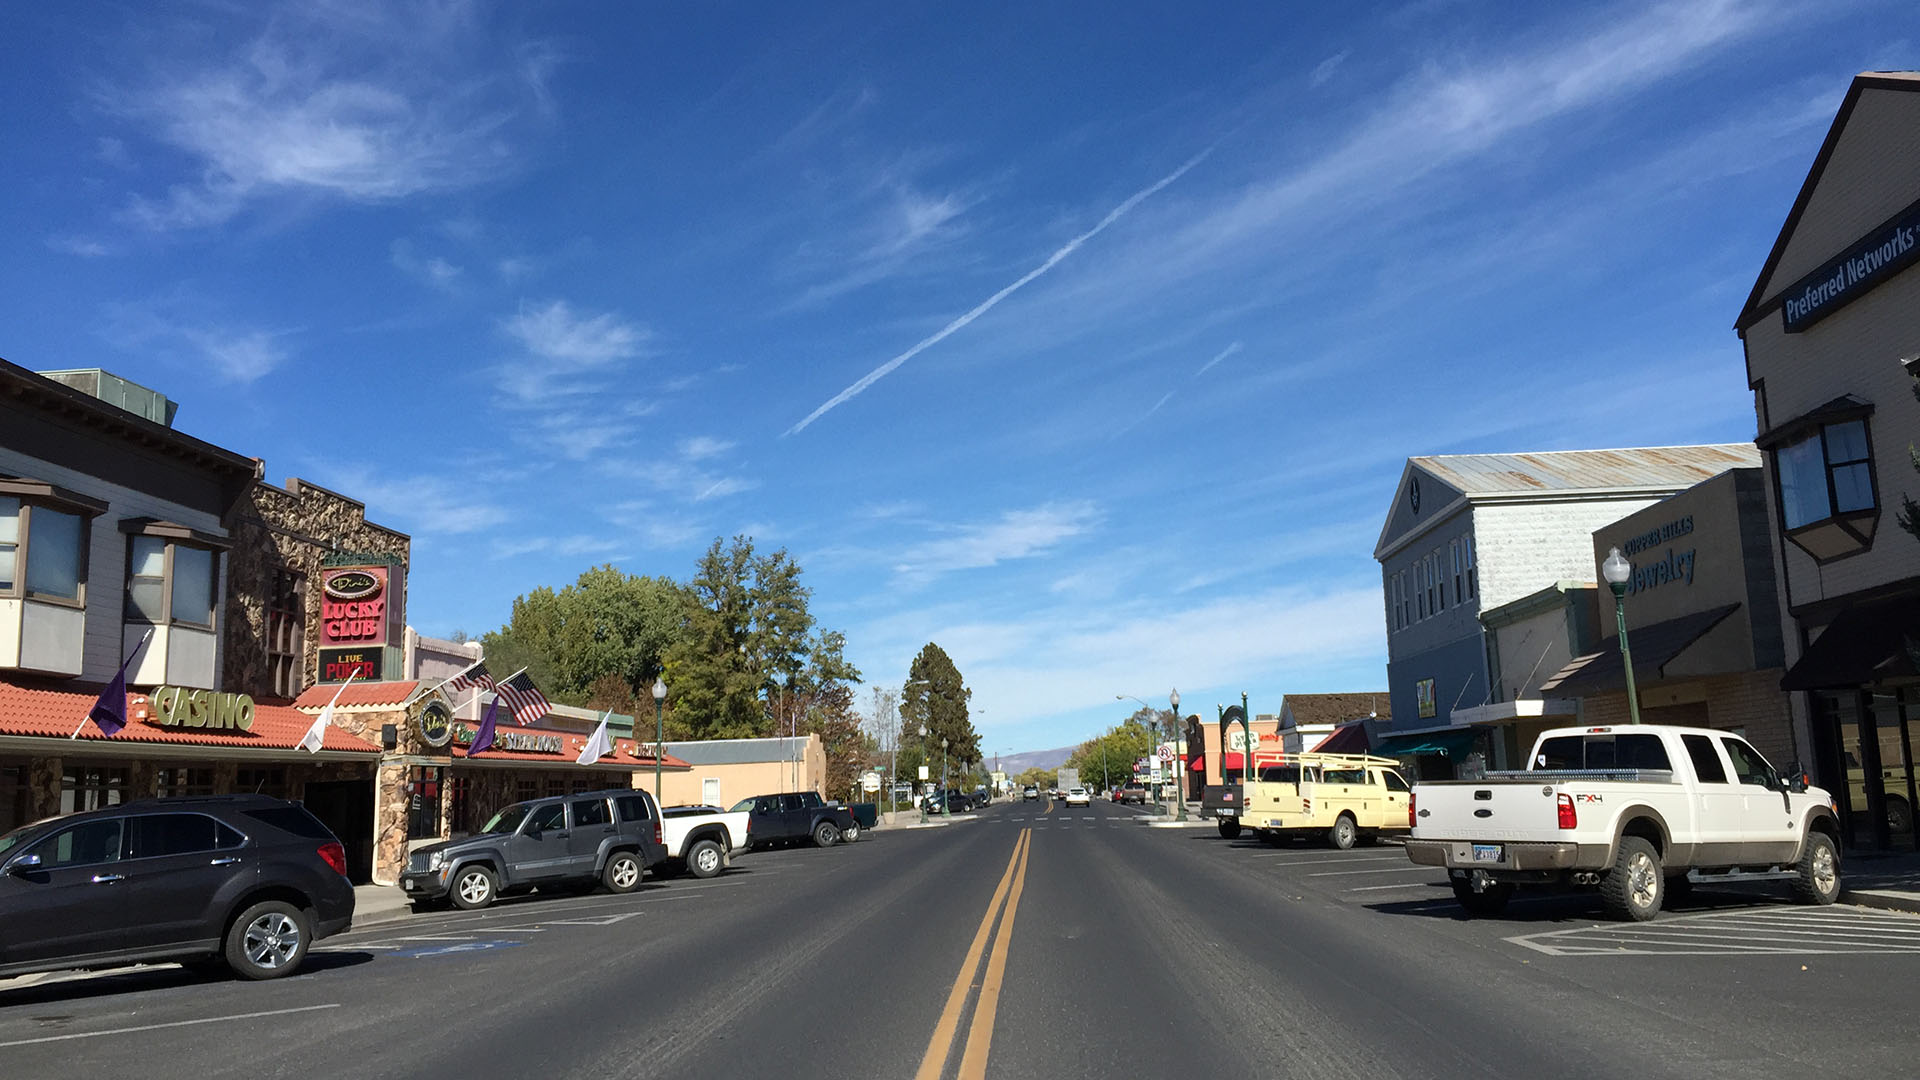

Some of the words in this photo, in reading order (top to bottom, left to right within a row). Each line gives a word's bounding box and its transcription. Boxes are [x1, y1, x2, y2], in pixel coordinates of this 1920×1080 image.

[1786, 265, 1847, 323] Preferred
[1846, 227, 1914, 286] Networks
[1624, 528, 1661, 557] COPPER
[1661, 514, 1694, 542] HILLS
[1627, 548, 1696, 597] Jewelry
[323, 602, 380, 619] LUCKY
[327, 620, 376, 637] CLUB
[338, 655, 363, 663] LIVE
[326, 662, 374, 679] POKER
[149, 686, 255, 731] CASINO
[1576, 794, 1603, 803] FX4
